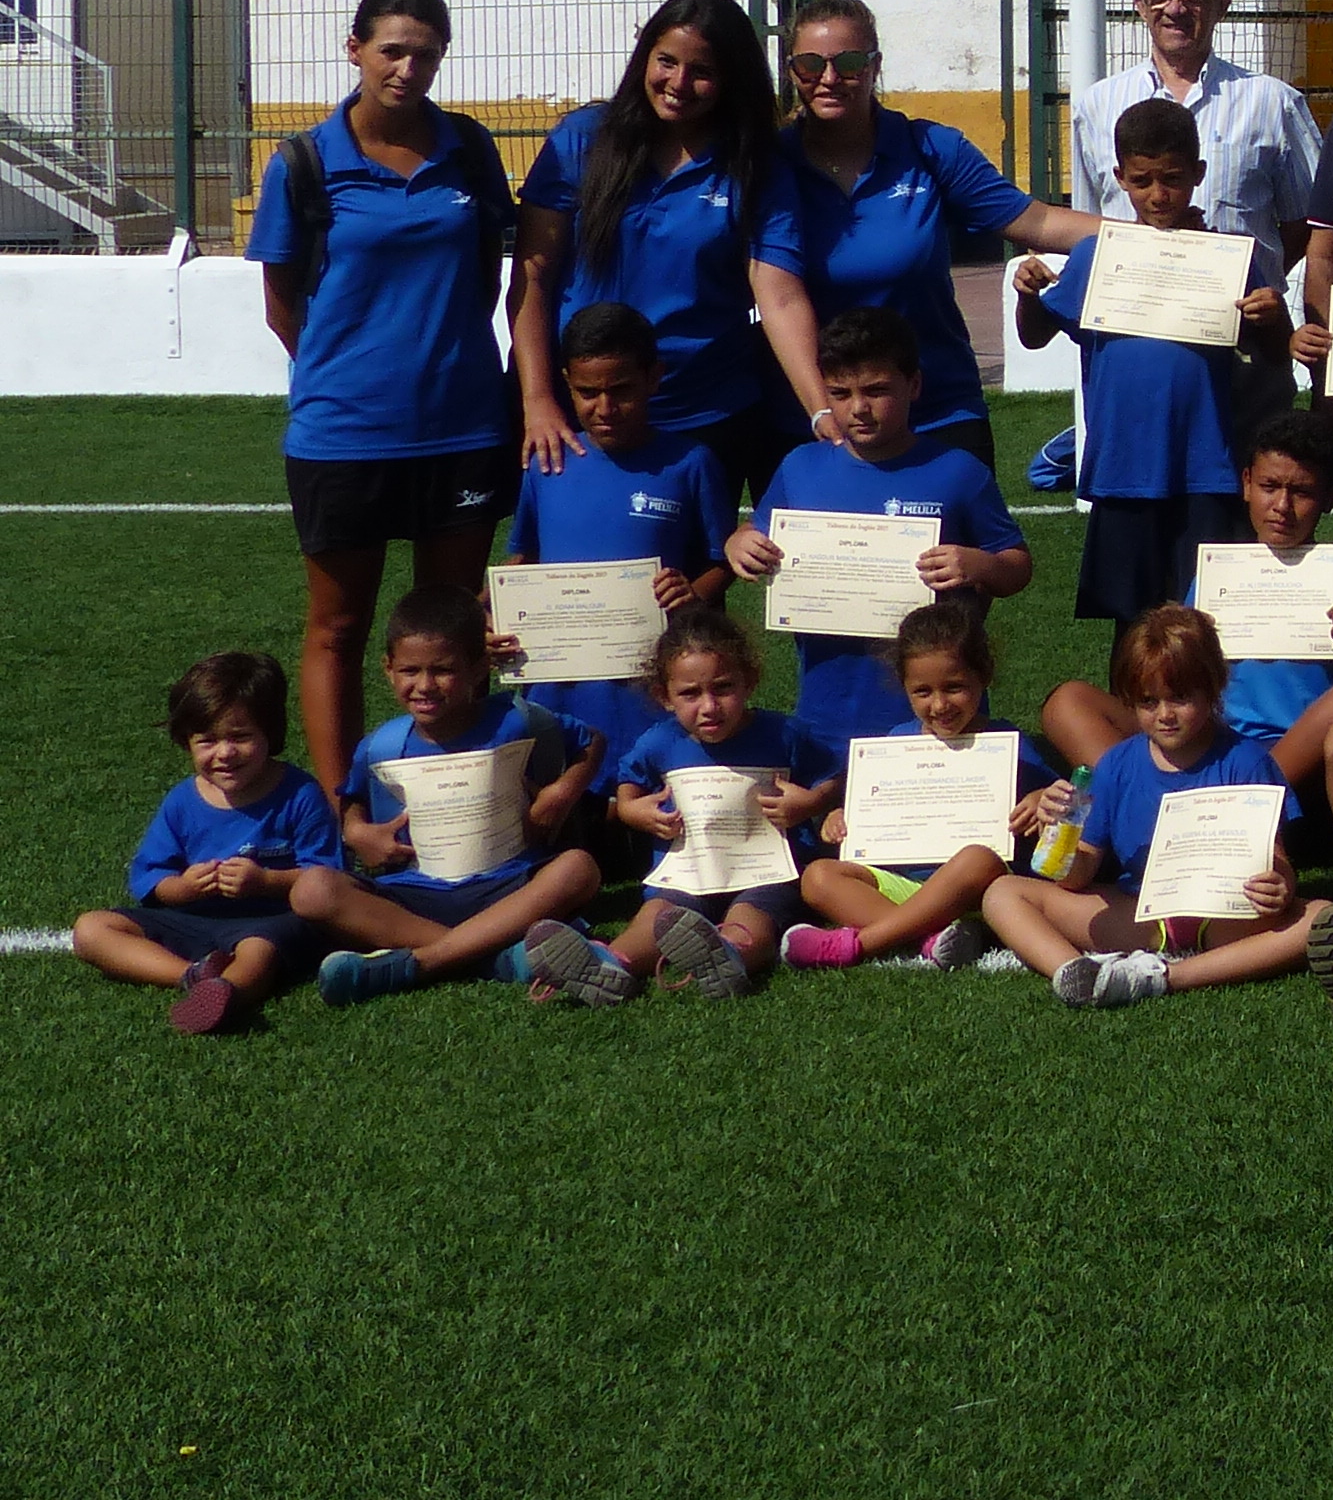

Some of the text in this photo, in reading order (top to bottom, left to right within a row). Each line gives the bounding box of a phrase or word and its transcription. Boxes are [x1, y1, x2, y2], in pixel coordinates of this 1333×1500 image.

[1159, 250, 1187, 259] DIPLOMA
[902, 505, 942, 515] MELILLA
[838, 539, 868, 547] DIPLOMA
[436, 780, 469, 789] DIPLOMA
